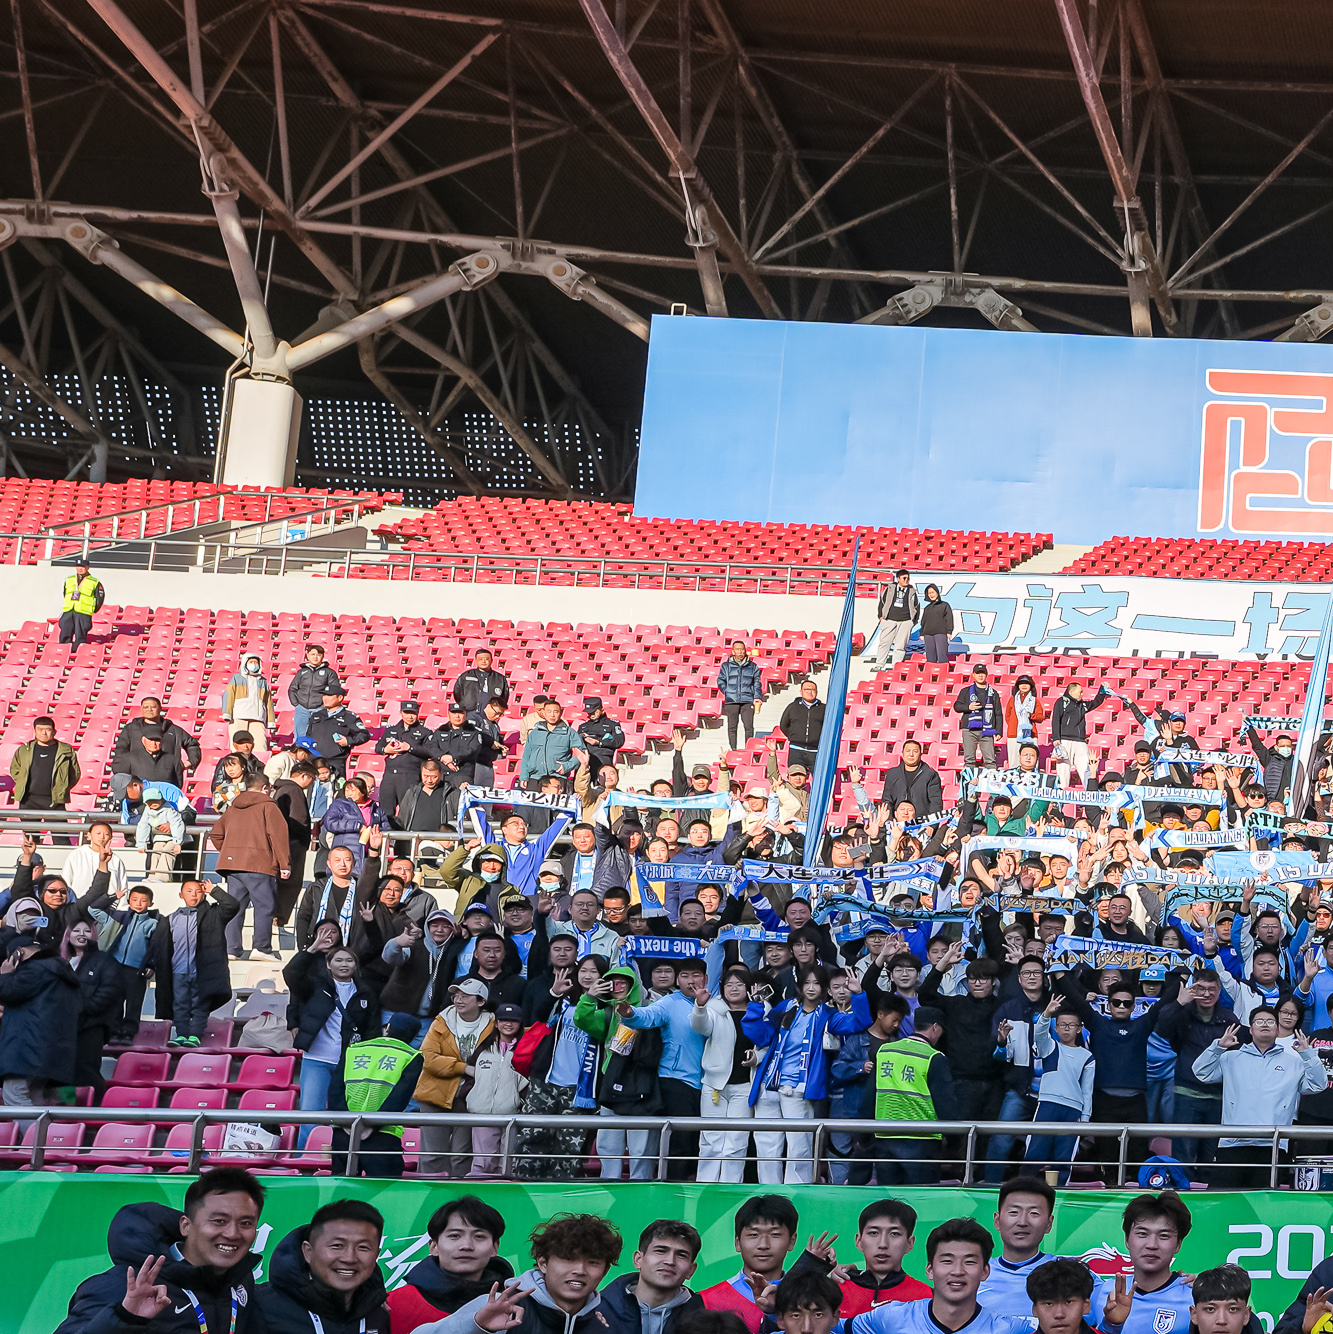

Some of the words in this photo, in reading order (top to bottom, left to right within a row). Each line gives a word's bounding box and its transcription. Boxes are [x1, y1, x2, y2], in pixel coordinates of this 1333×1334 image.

[1173, 748, 1207, 762] 大连
[1031, 786, 1062, 799] DALIAN
[1064, 789, 1097, 803] YINGBO
[1098, 791, 1110, 804] FC
[1145, 786, 1214, 803] DALIAN
[1186, 830, 1220, 845] DALIAN
[761, 863, 813, 881] 大连
[639, 938, 669, 956] next
[672, 939, 696, 957] the
[352, 1051, 398, 1072] 安保
[879, 1060, 917, 1084] 安保
